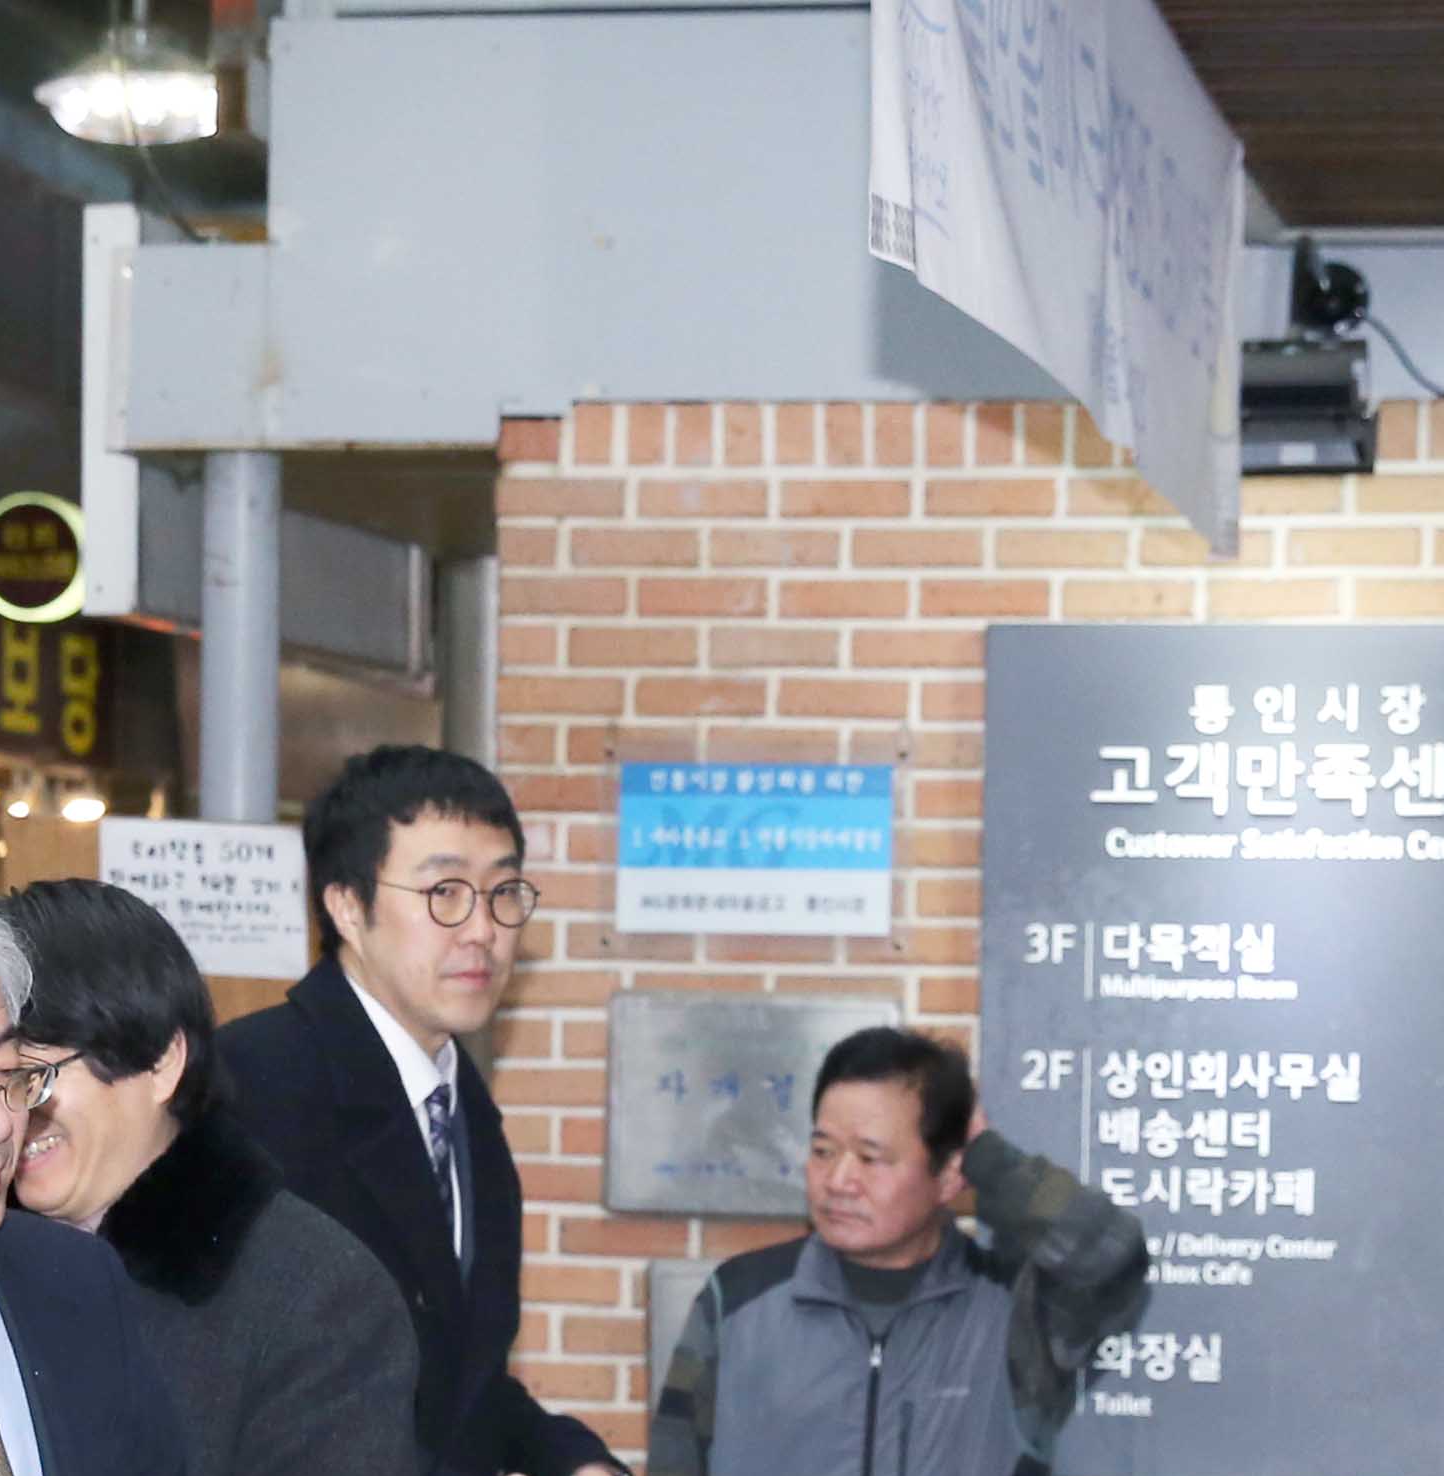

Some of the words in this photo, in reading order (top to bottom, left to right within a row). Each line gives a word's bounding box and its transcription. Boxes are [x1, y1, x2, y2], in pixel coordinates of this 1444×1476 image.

[1187, 683, 1427, 735] 통인시장
[1105, 827, 1237, 860] Customer
[1240, 828, 1405, 861] Satisfaction
[1022, 922, 1077, 965] 3F
[1102, 922, 1276, 974] 다목적실
[1020, 1049, 1075, 1090] 2F
[1099, 1049, 1362, 1103] 상인회사무실
[1097, 1108, 1272, 1159] 배송센터
[1100, 1167, 1316, 1216] 도시락카페
[1178, 1234, 1264, 1261] Delivery
[1265, 1234, 1338, 1260] Center
[1202, 1263, 1253, 1286] Cafe
[1092, 1332, 1224, 1384] 화장실
